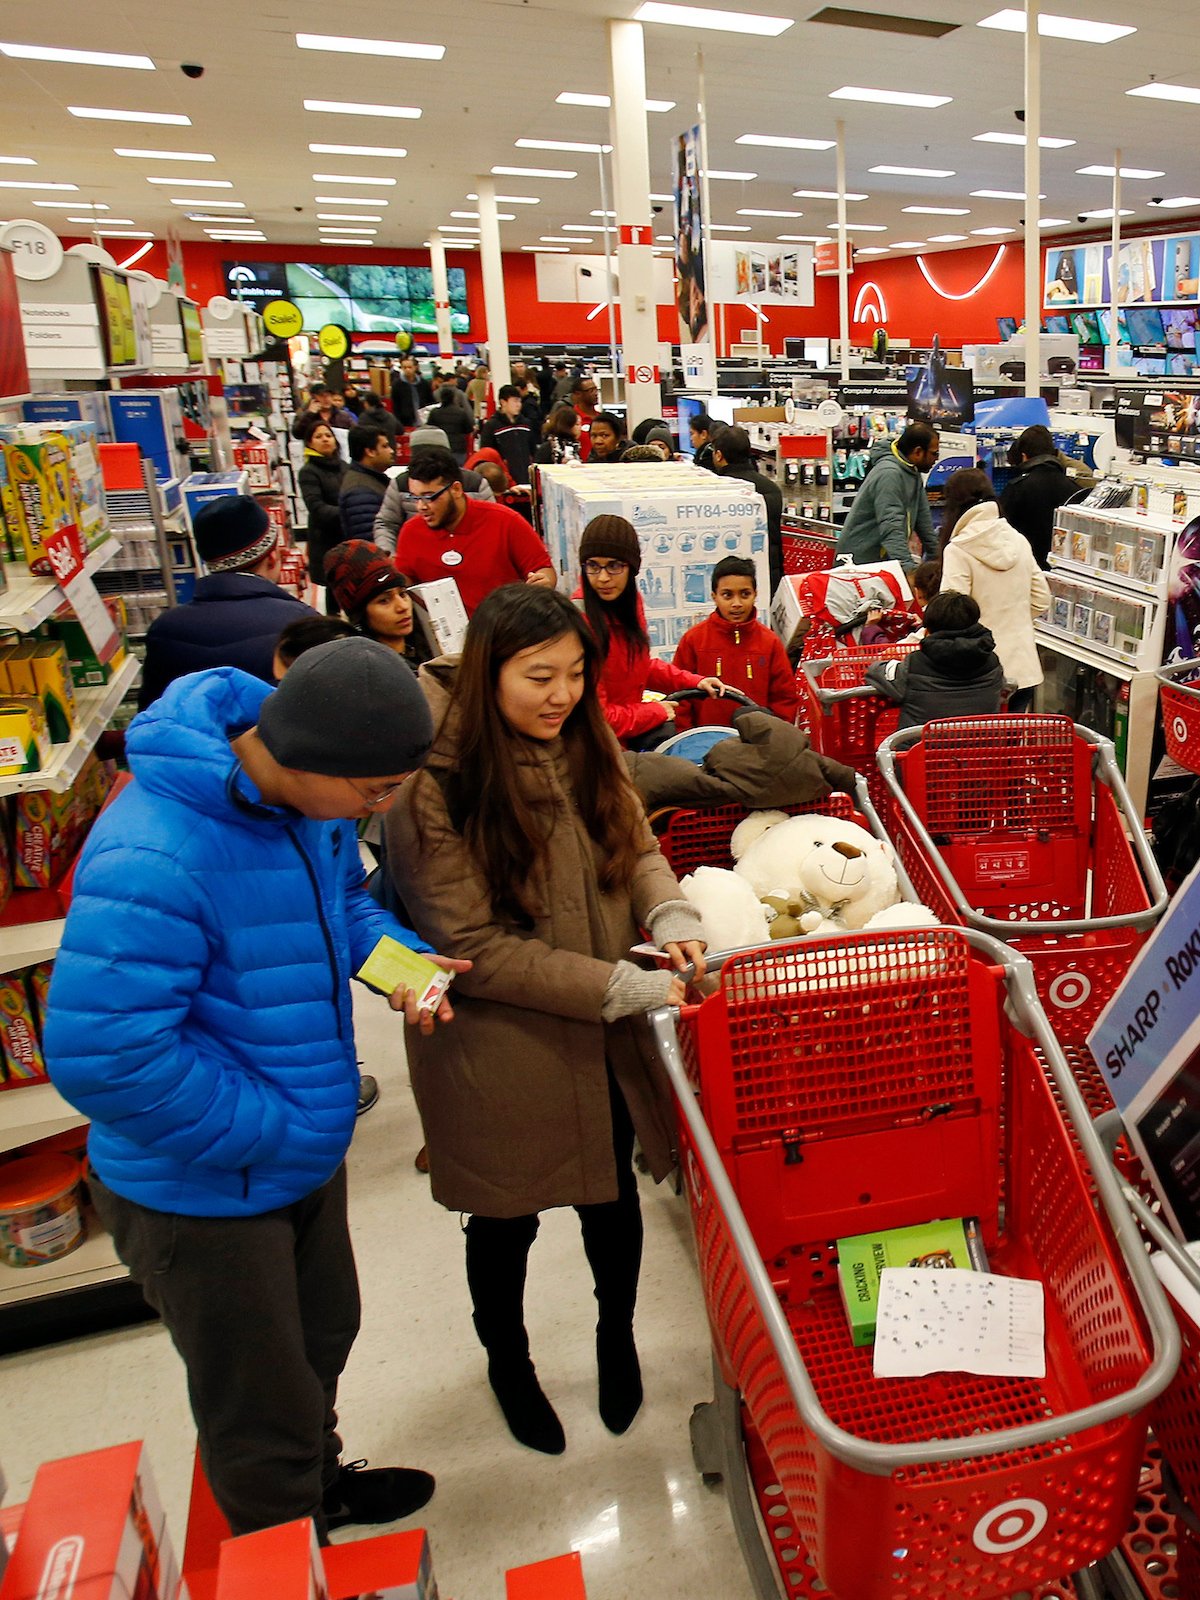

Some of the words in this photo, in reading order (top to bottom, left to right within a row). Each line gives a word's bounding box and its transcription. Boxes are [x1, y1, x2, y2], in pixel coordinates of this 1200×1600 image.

[12, 240, 46, 255] F18
[269, 313, 297, 325] Sale!
[28, 331, 62, 339] Folders
[842, 387, 873, 395] Computer
[873, 387, 908, 395] Accessories
[677, 503, 760, 519] FFY84-9997
[48, 535, 77, 580] Sale!
[33, 823, 46, 873] CREATIVE
[14, 1017, 34, 1064] CREATIVE
[1105, 988, 1161, 1079] SHARP
[857, 1261, 872, 1304] CRACKING
